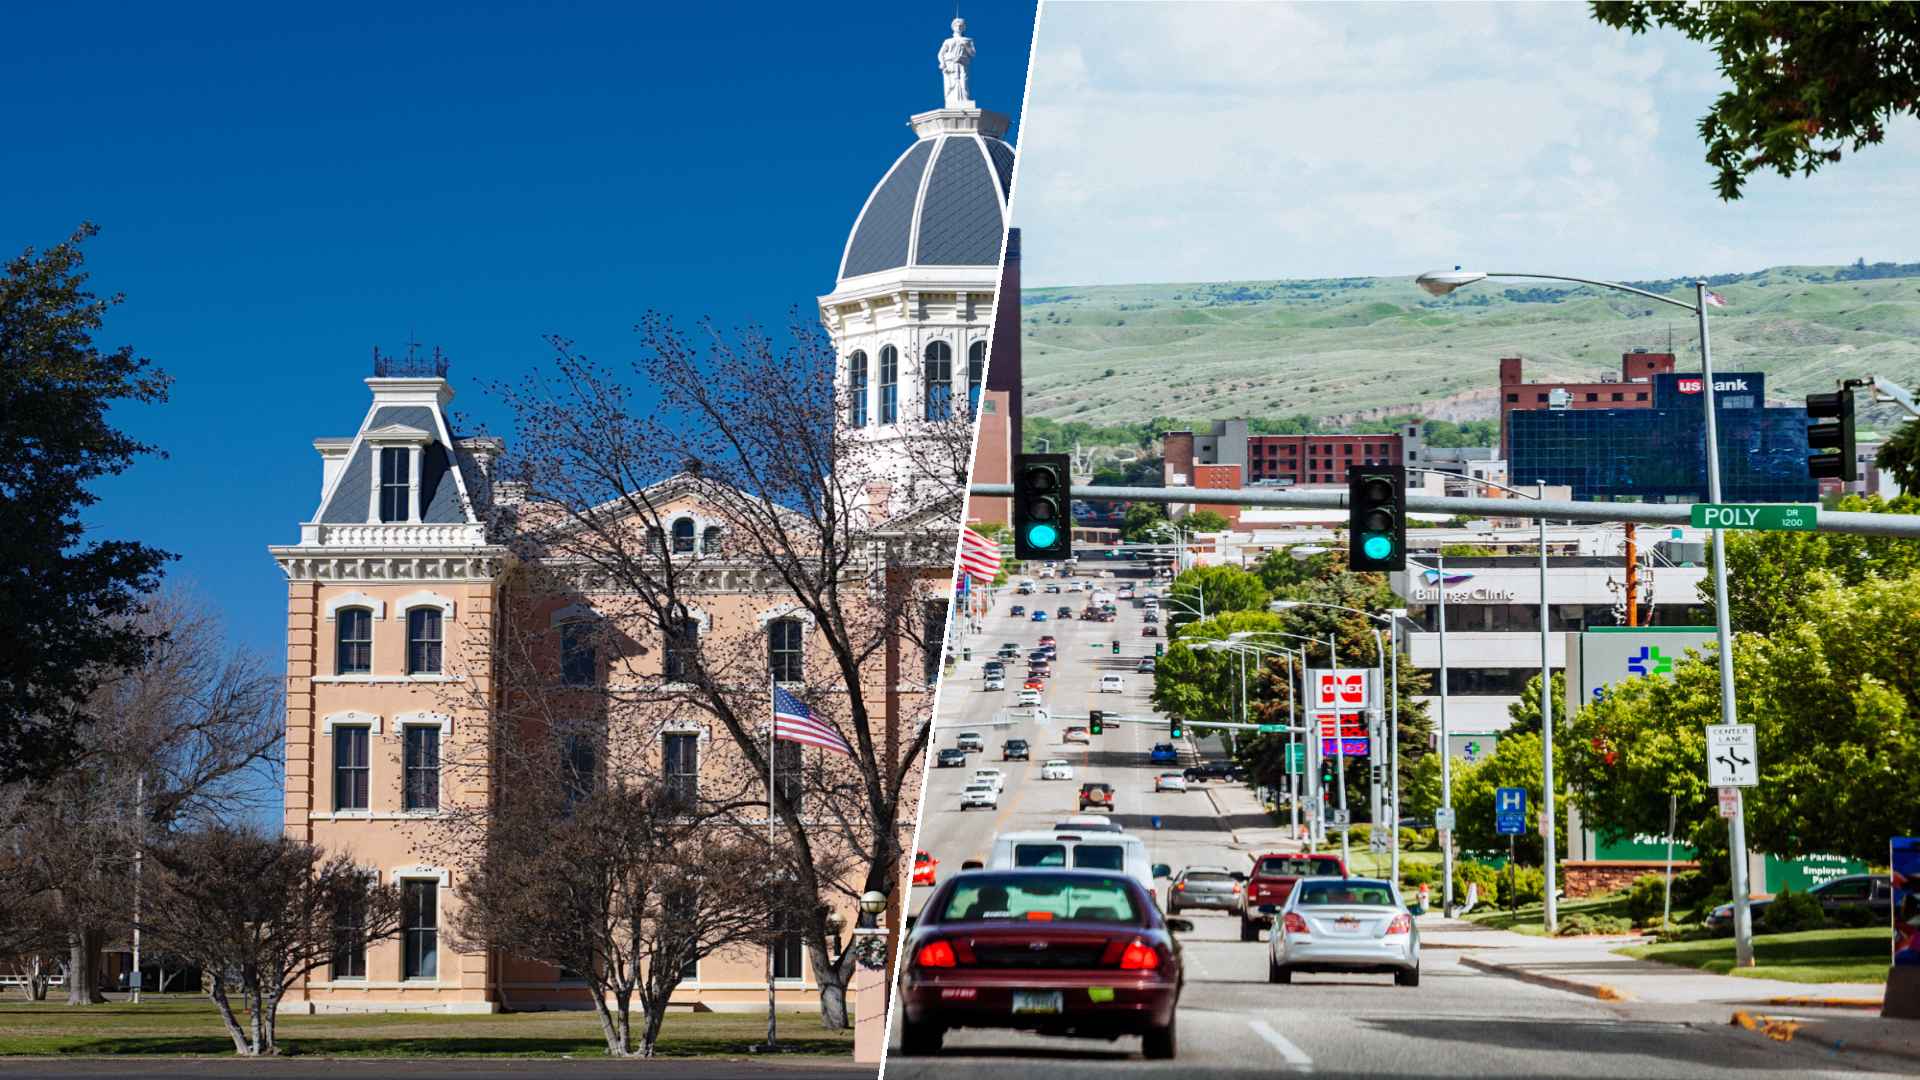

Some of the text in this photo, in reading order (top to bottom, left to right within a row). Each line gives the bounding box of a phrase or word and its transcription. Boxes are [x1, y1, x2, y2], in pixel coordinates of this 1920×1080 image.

[1705, 508, 1760, 526] POLY
[1786, 509, 1799, 517] DR
[1782, 518, 1803, 527] 1200
[1416, 587, 1515, 603] Billngs Clinic
[1503, 792, 1520, 809] H
[1802, 866, 1847, 876] Employee
